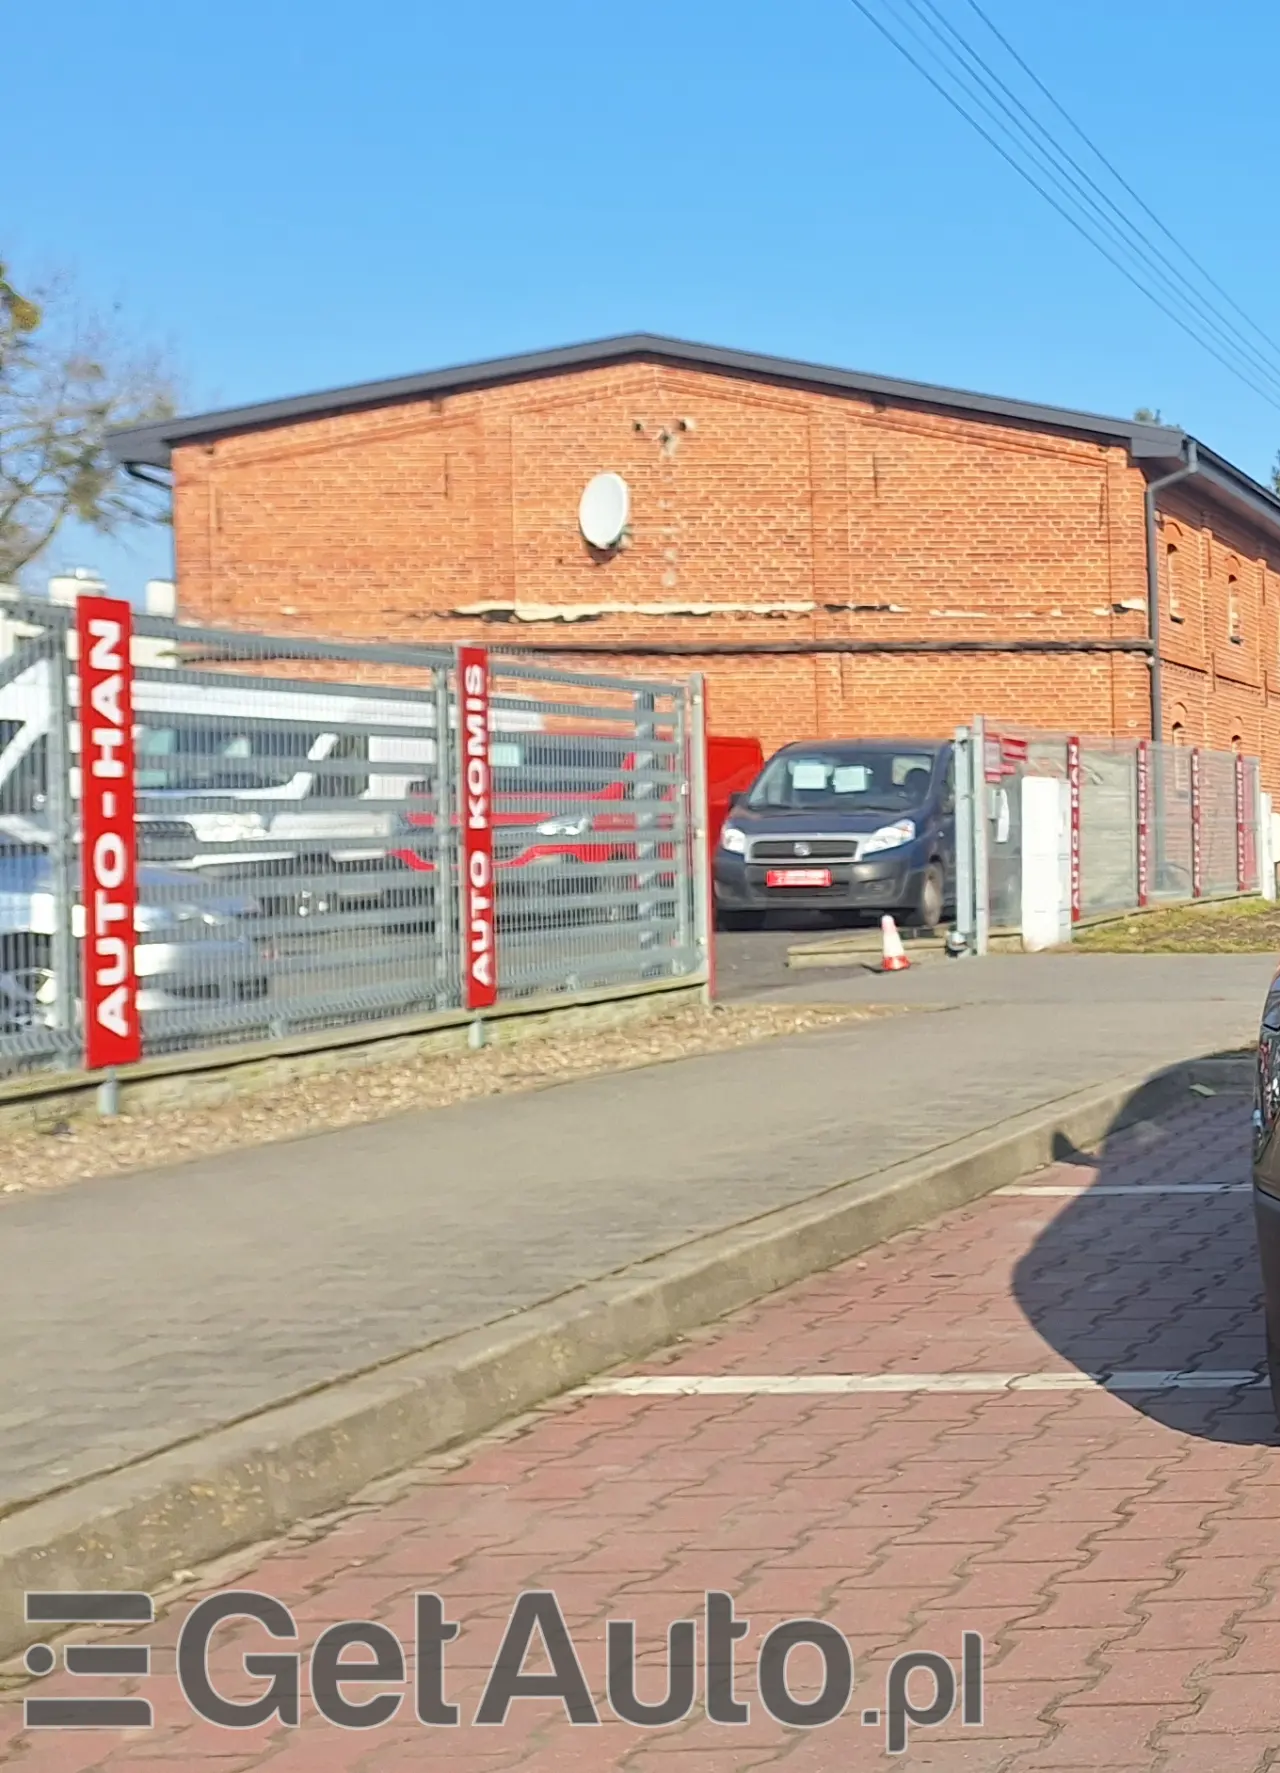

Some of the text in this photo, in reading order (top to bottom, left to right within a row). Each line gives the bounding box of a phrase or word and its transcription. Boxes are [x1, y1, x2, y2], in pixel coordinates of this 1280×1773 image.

[89, 619, 125, 778] HAN
[464, 663, 493, 987] AUTO KOMIS
[93, 832, 129, 1037] AUTO
